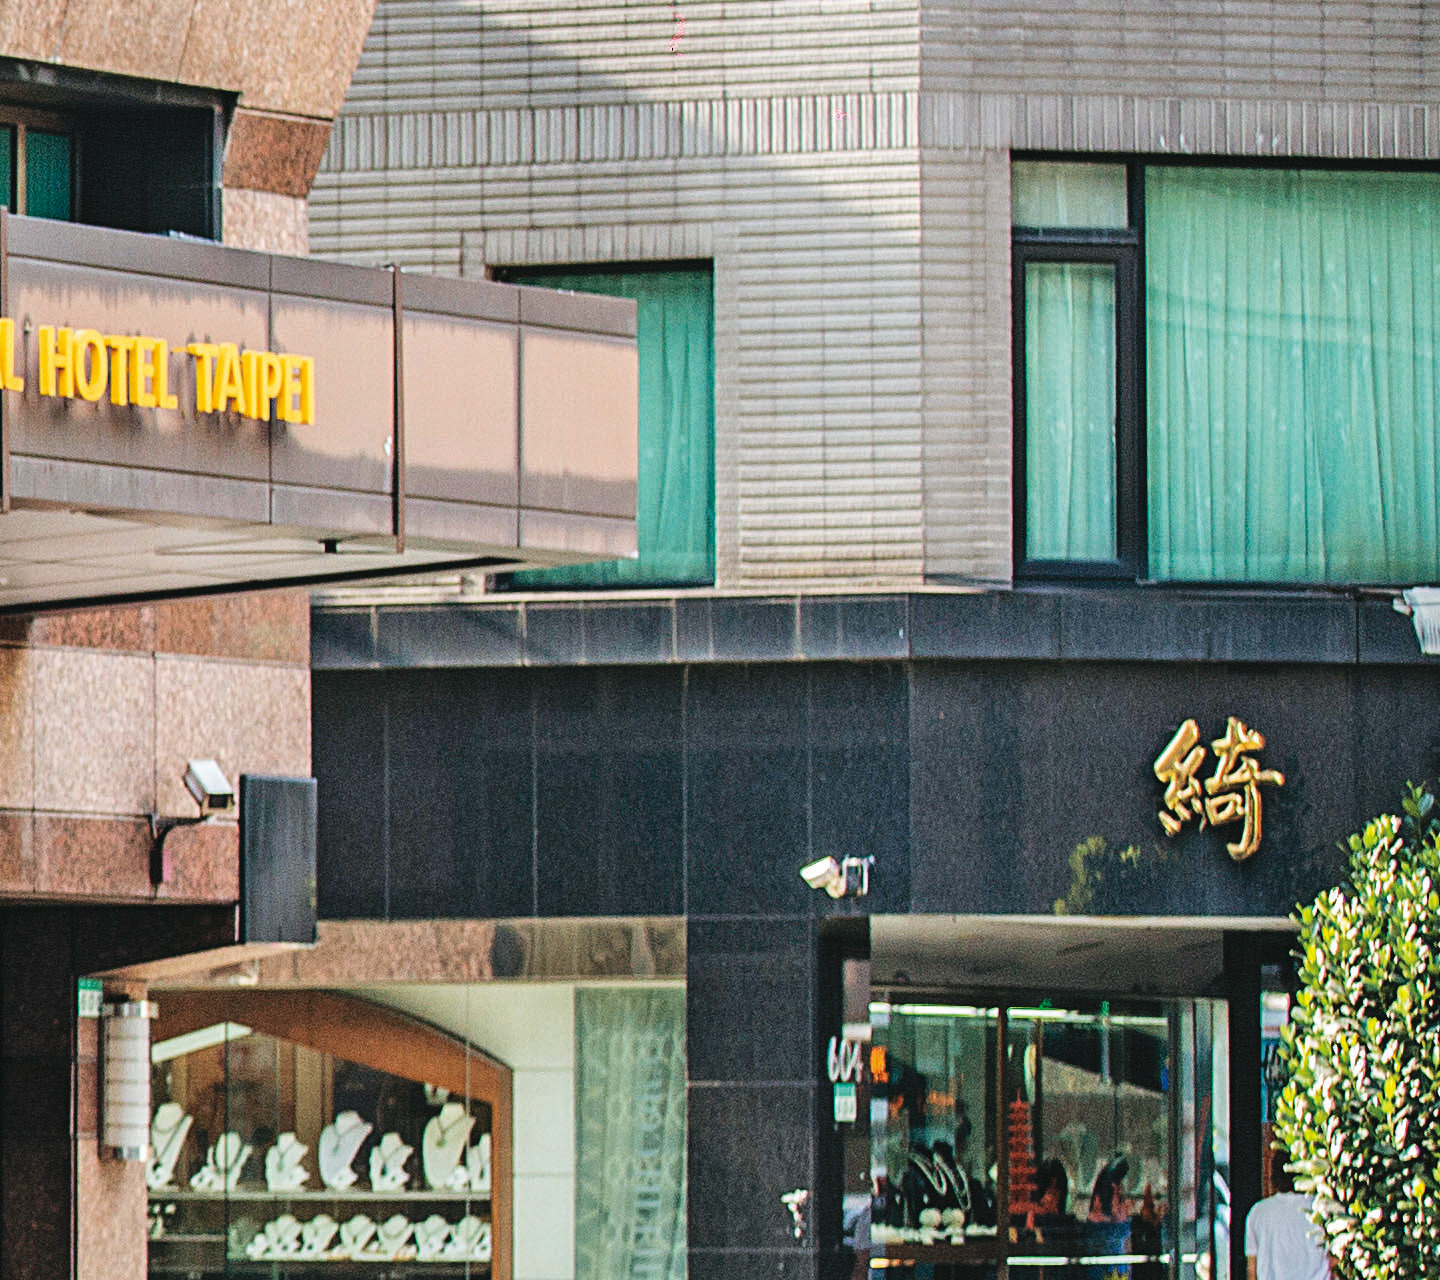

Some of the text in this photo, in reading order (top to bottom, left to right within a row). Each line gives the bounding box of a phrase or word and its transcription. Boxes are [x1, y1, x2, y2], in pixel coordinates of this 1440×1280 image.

[38, 325, 178, 409] HOTEL
[187, 342, 314, 425] TAIPEI
[1153, 716, 1285, 862] 綺
[827, 1036, 864, 1082] 604
